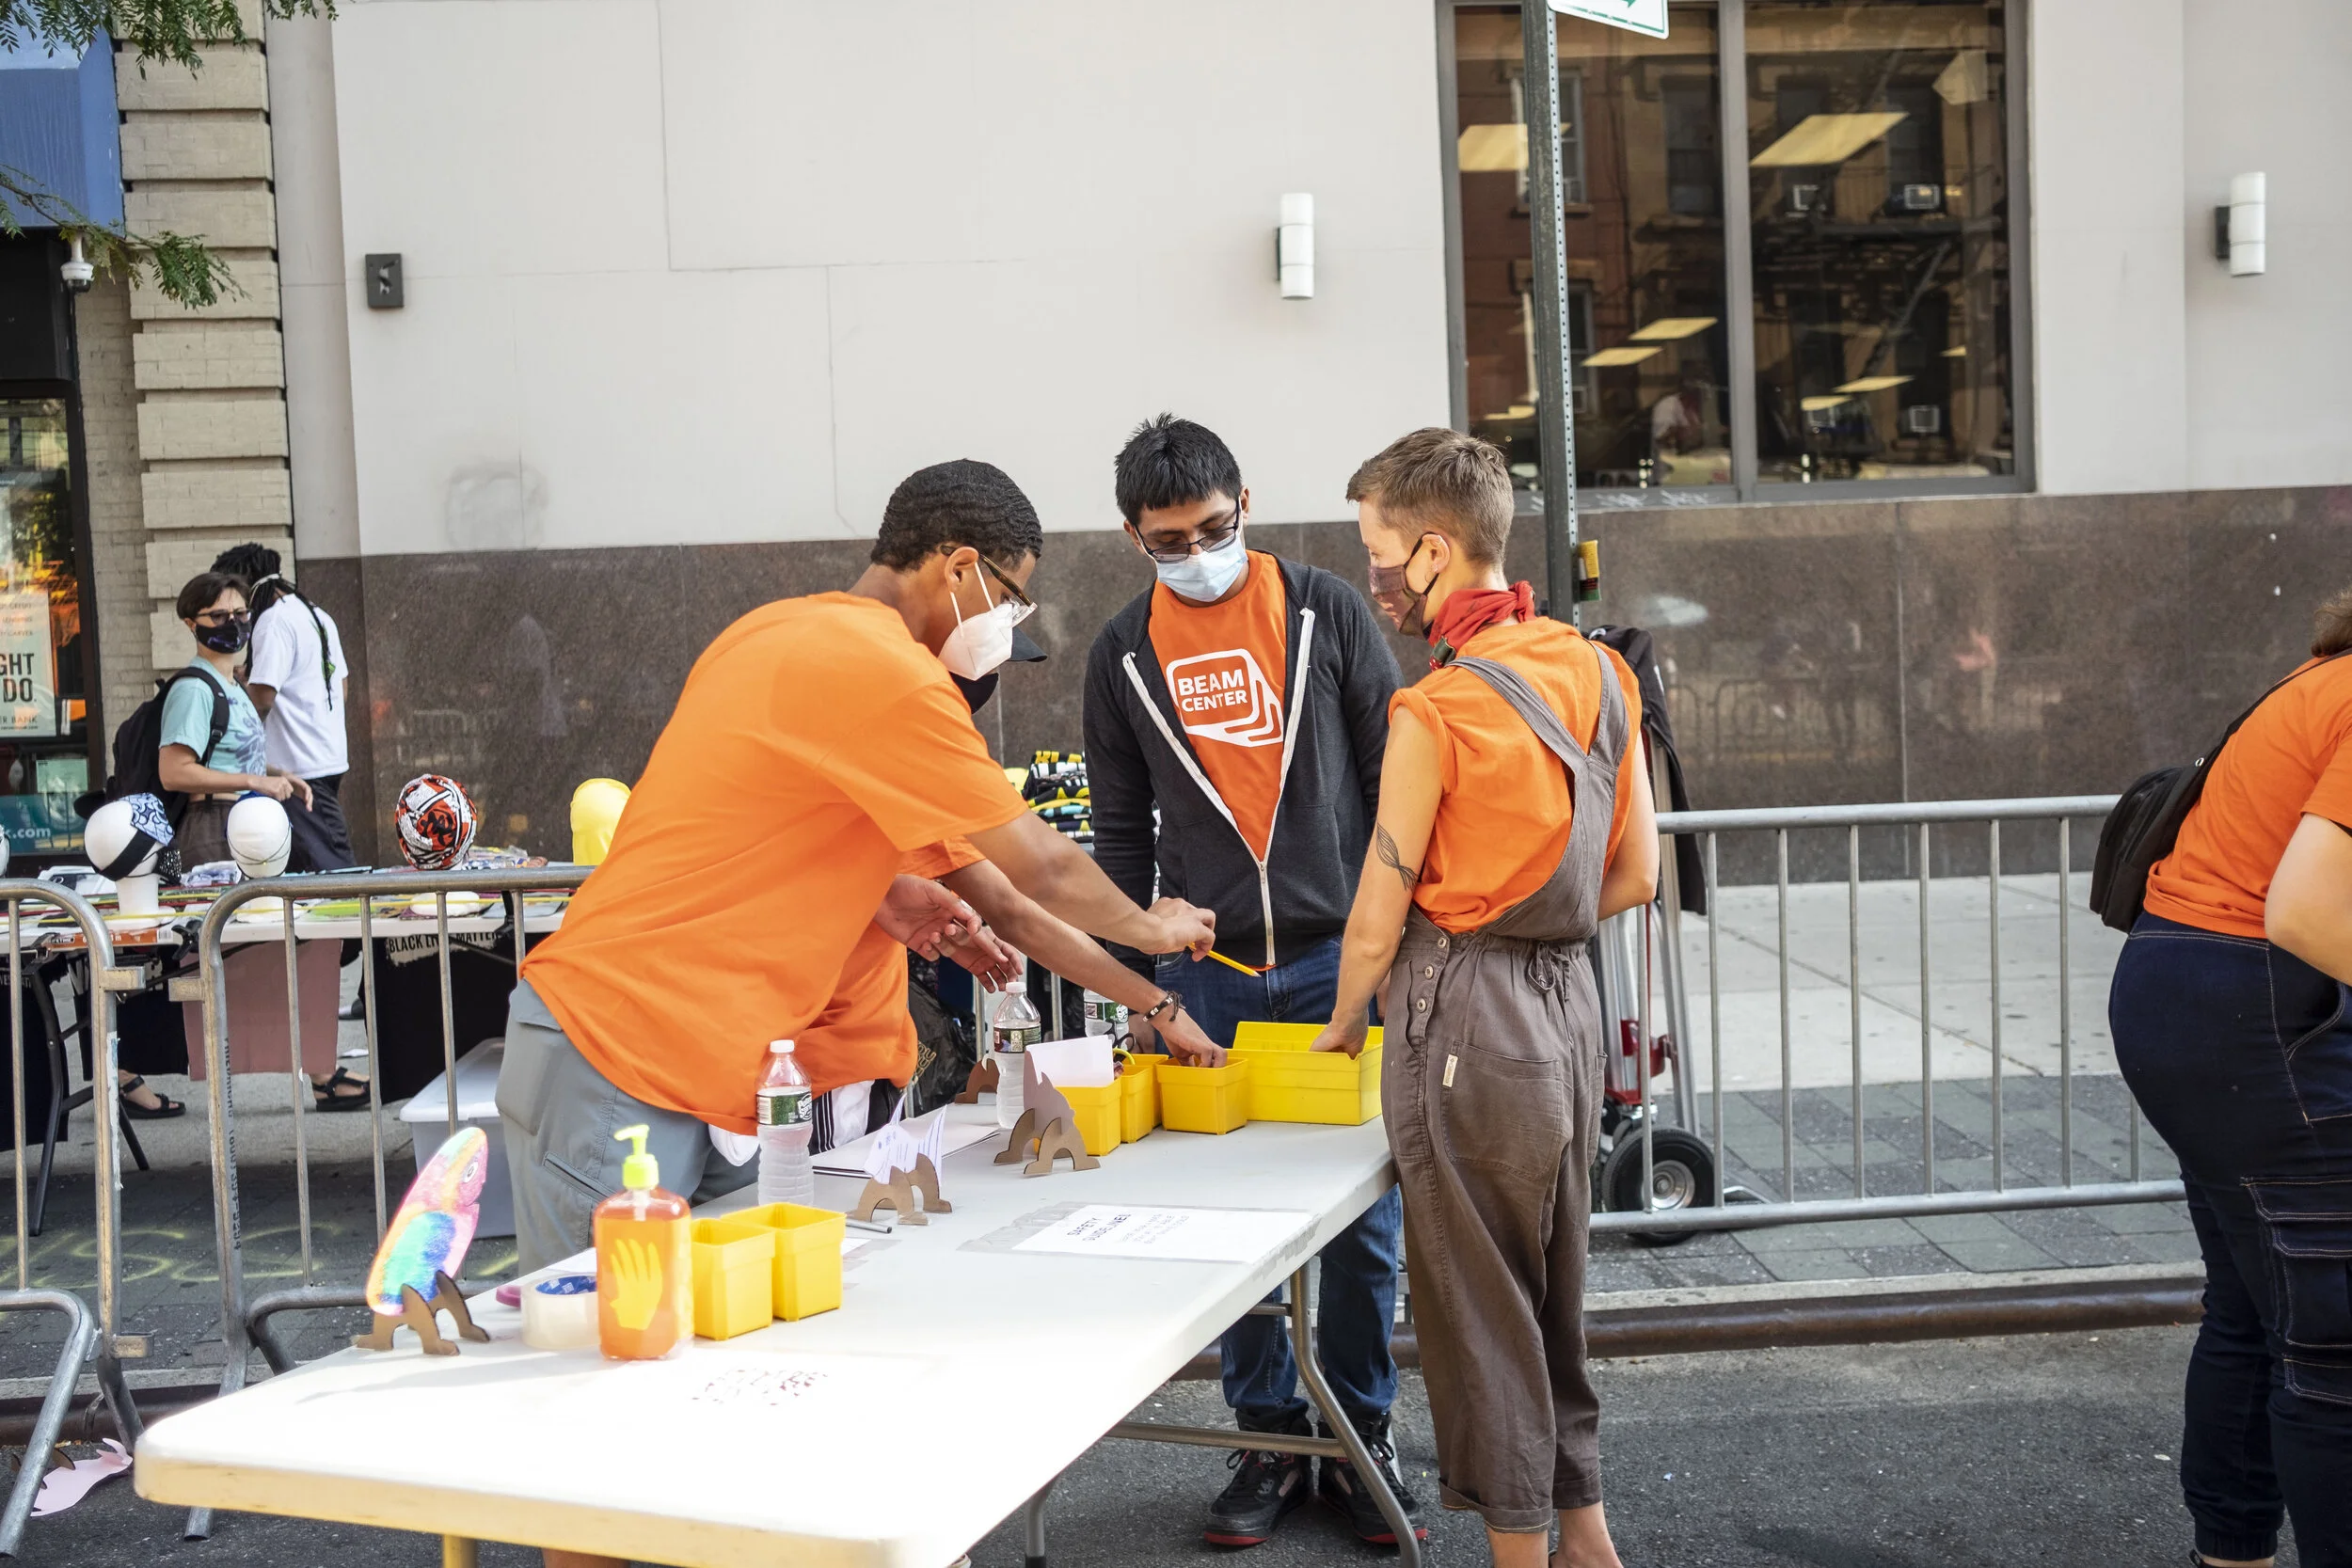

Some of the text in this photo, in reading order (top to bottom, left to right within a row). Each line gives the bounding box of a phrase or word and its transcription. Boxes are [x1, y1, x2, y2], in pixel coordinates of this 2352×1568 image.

[1178, 669, 1245, 696] BEAM
[1182, 689, 1248, 712] CENTER
[389, 935, 423, 954] BLACK
